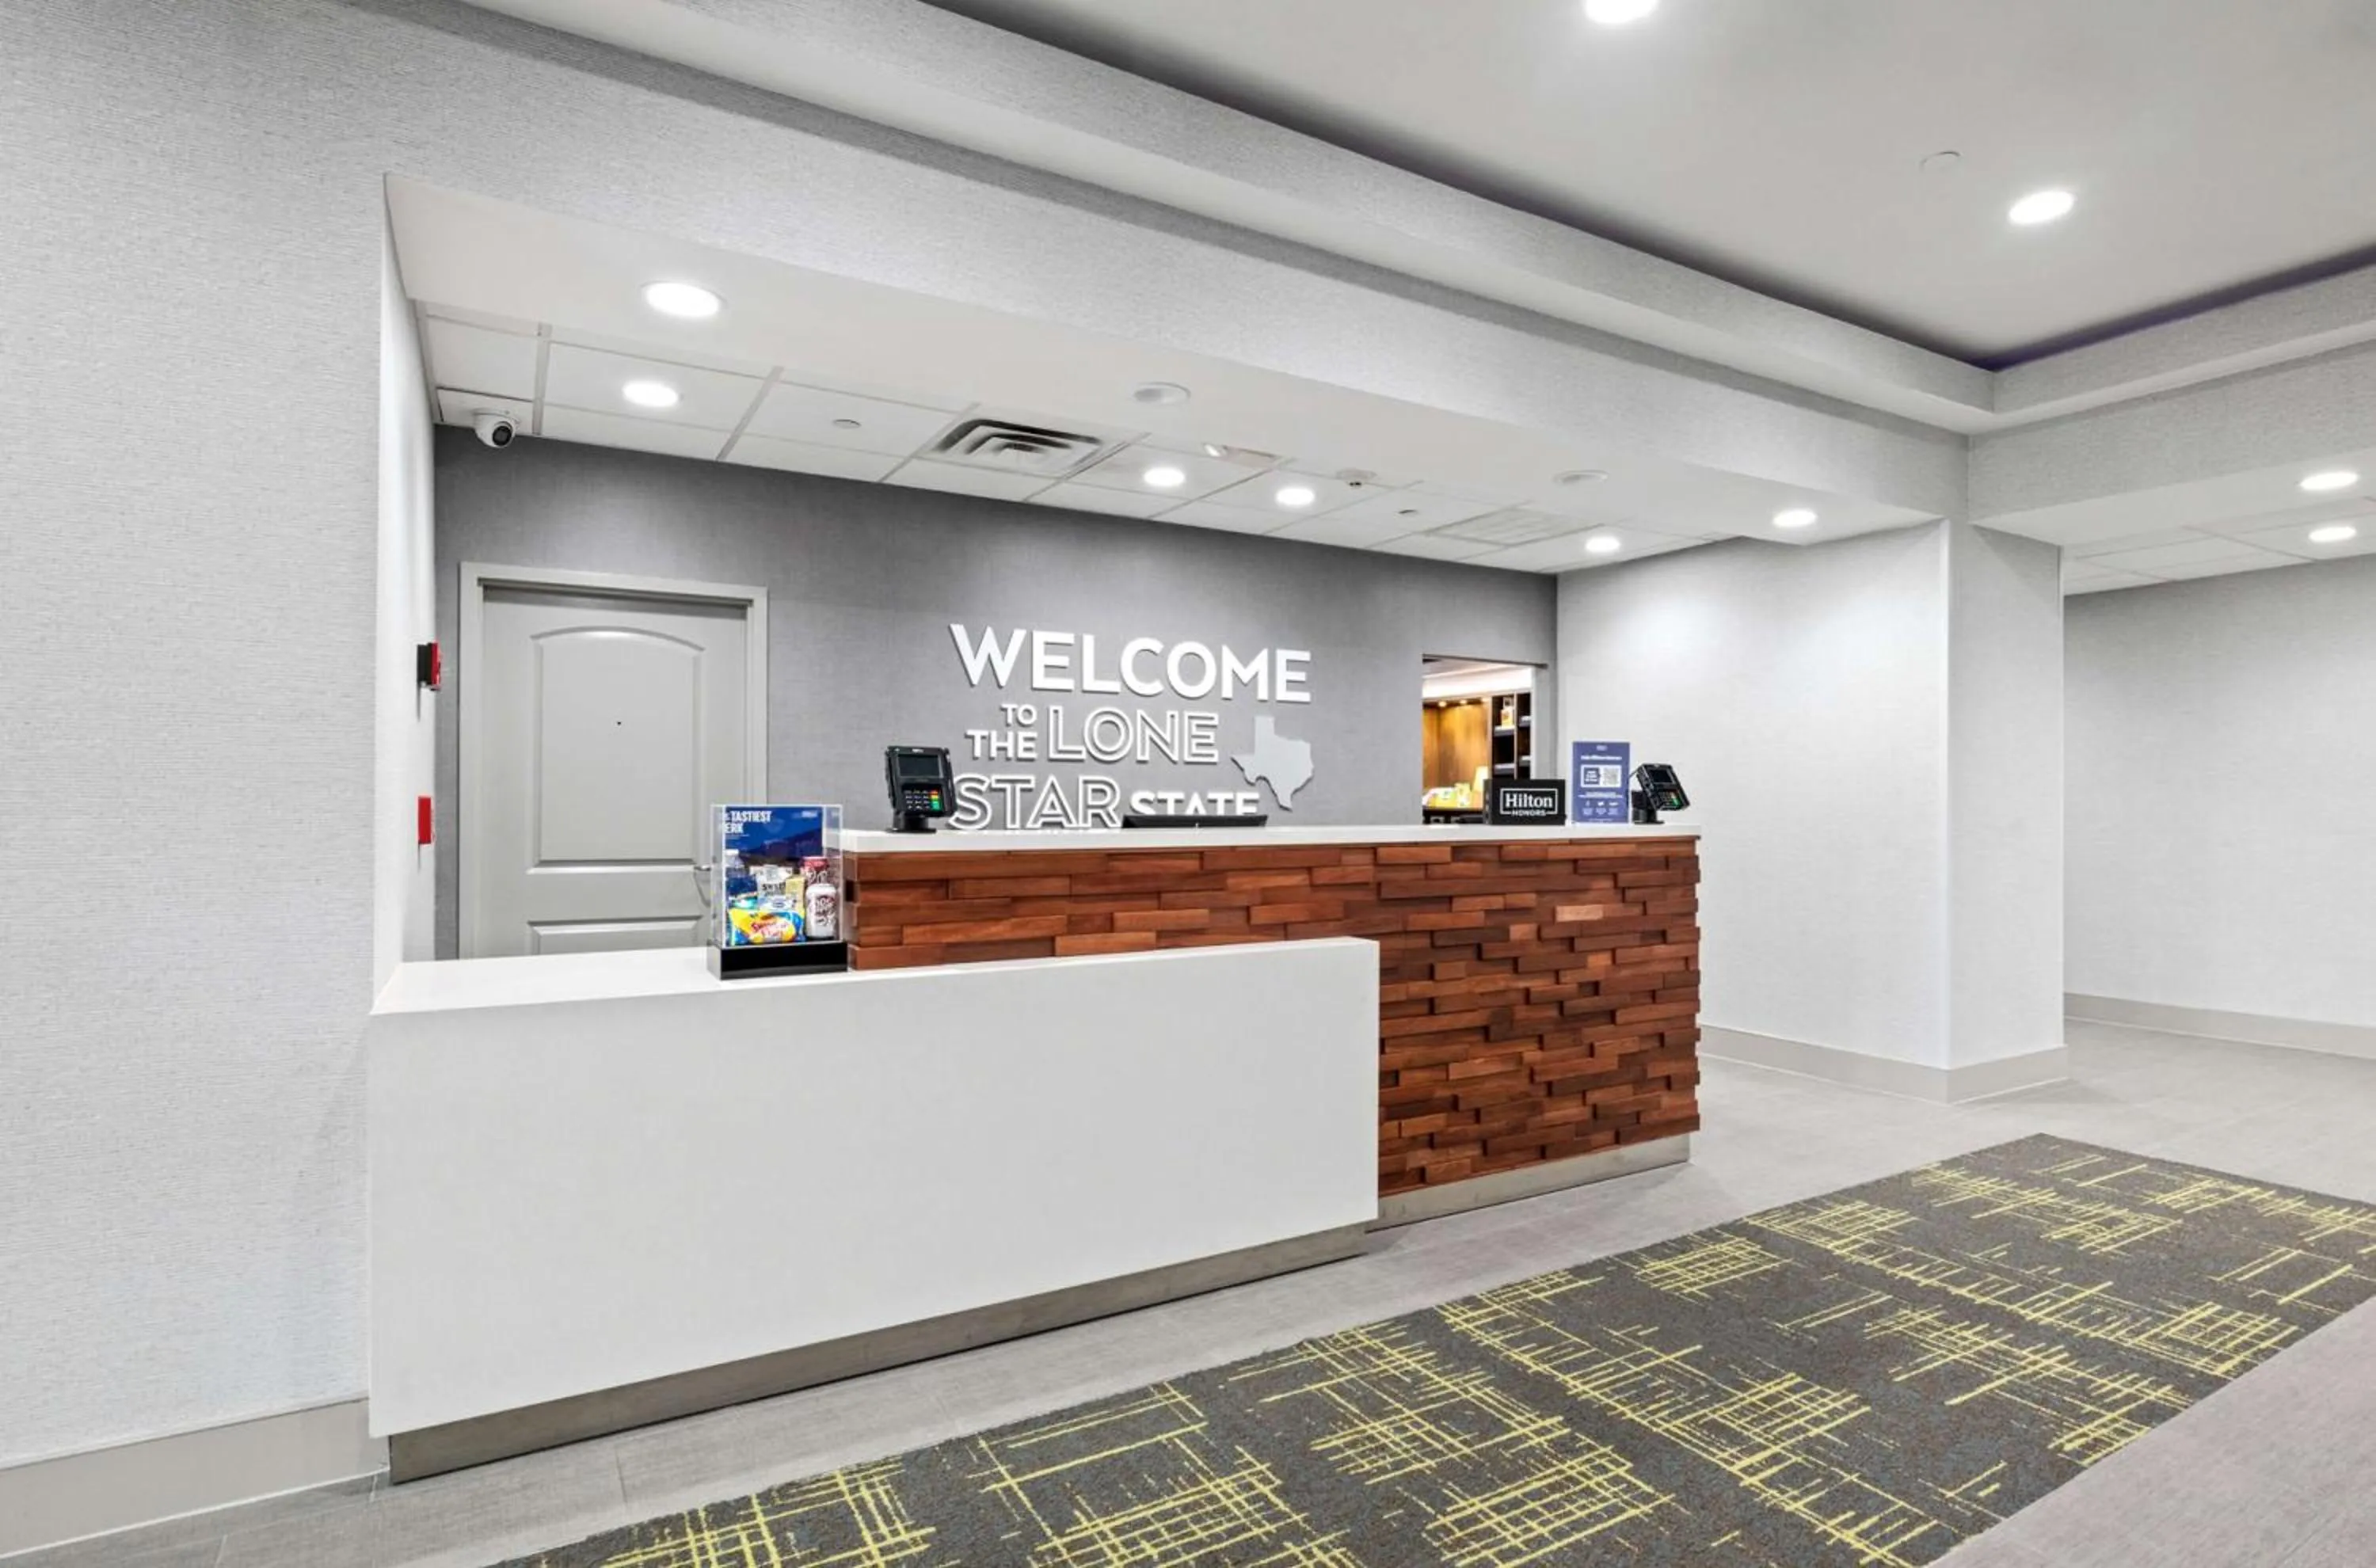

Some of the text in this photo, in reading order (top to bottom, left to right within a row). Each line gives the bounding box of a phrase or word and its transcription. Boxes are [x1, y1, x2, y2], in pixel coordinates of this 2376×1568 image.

[950, 623, 1312, 703] WELCOME
[1001, 703, 1038, 726] TO
[965, 705, 1220, 764] THE LONE
[949, 773, 1121, 830] STAR
[1129, 790, 1260, 816] STATE
[1505, 793, 1553, 808] Hilton
[730, 810, 772, 823] TASTIEST
[724, 823, 744, 834] ERK
